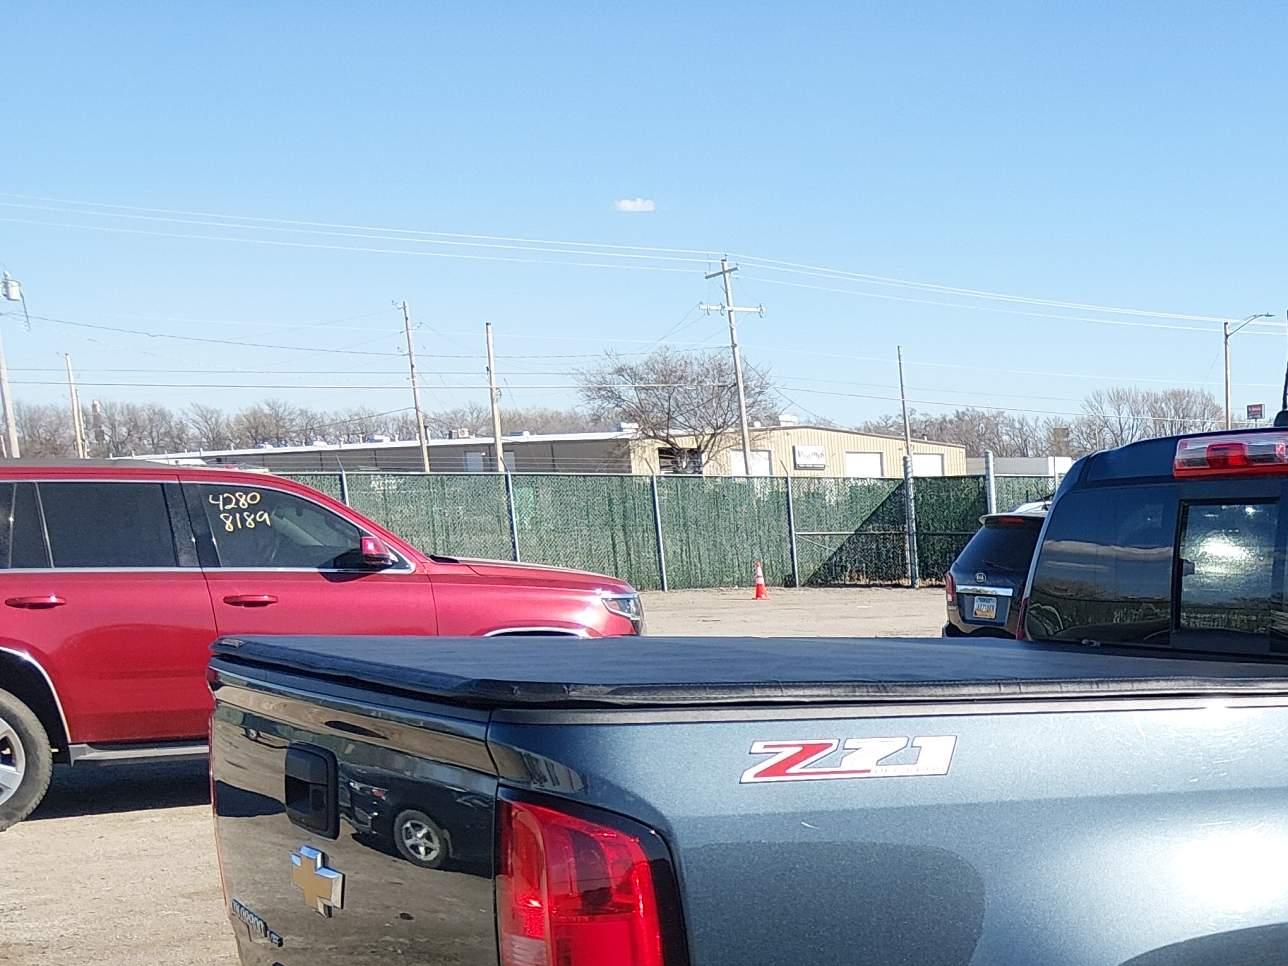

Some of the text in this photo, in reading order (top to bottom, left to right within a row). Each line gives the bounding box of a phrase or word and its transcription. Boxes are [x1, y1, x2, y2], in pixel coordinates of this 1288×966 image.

[208, 491, 261, 512] 4280
[219, 510, 272, 532] 8189
[740, 735, 957, 784] Z71
